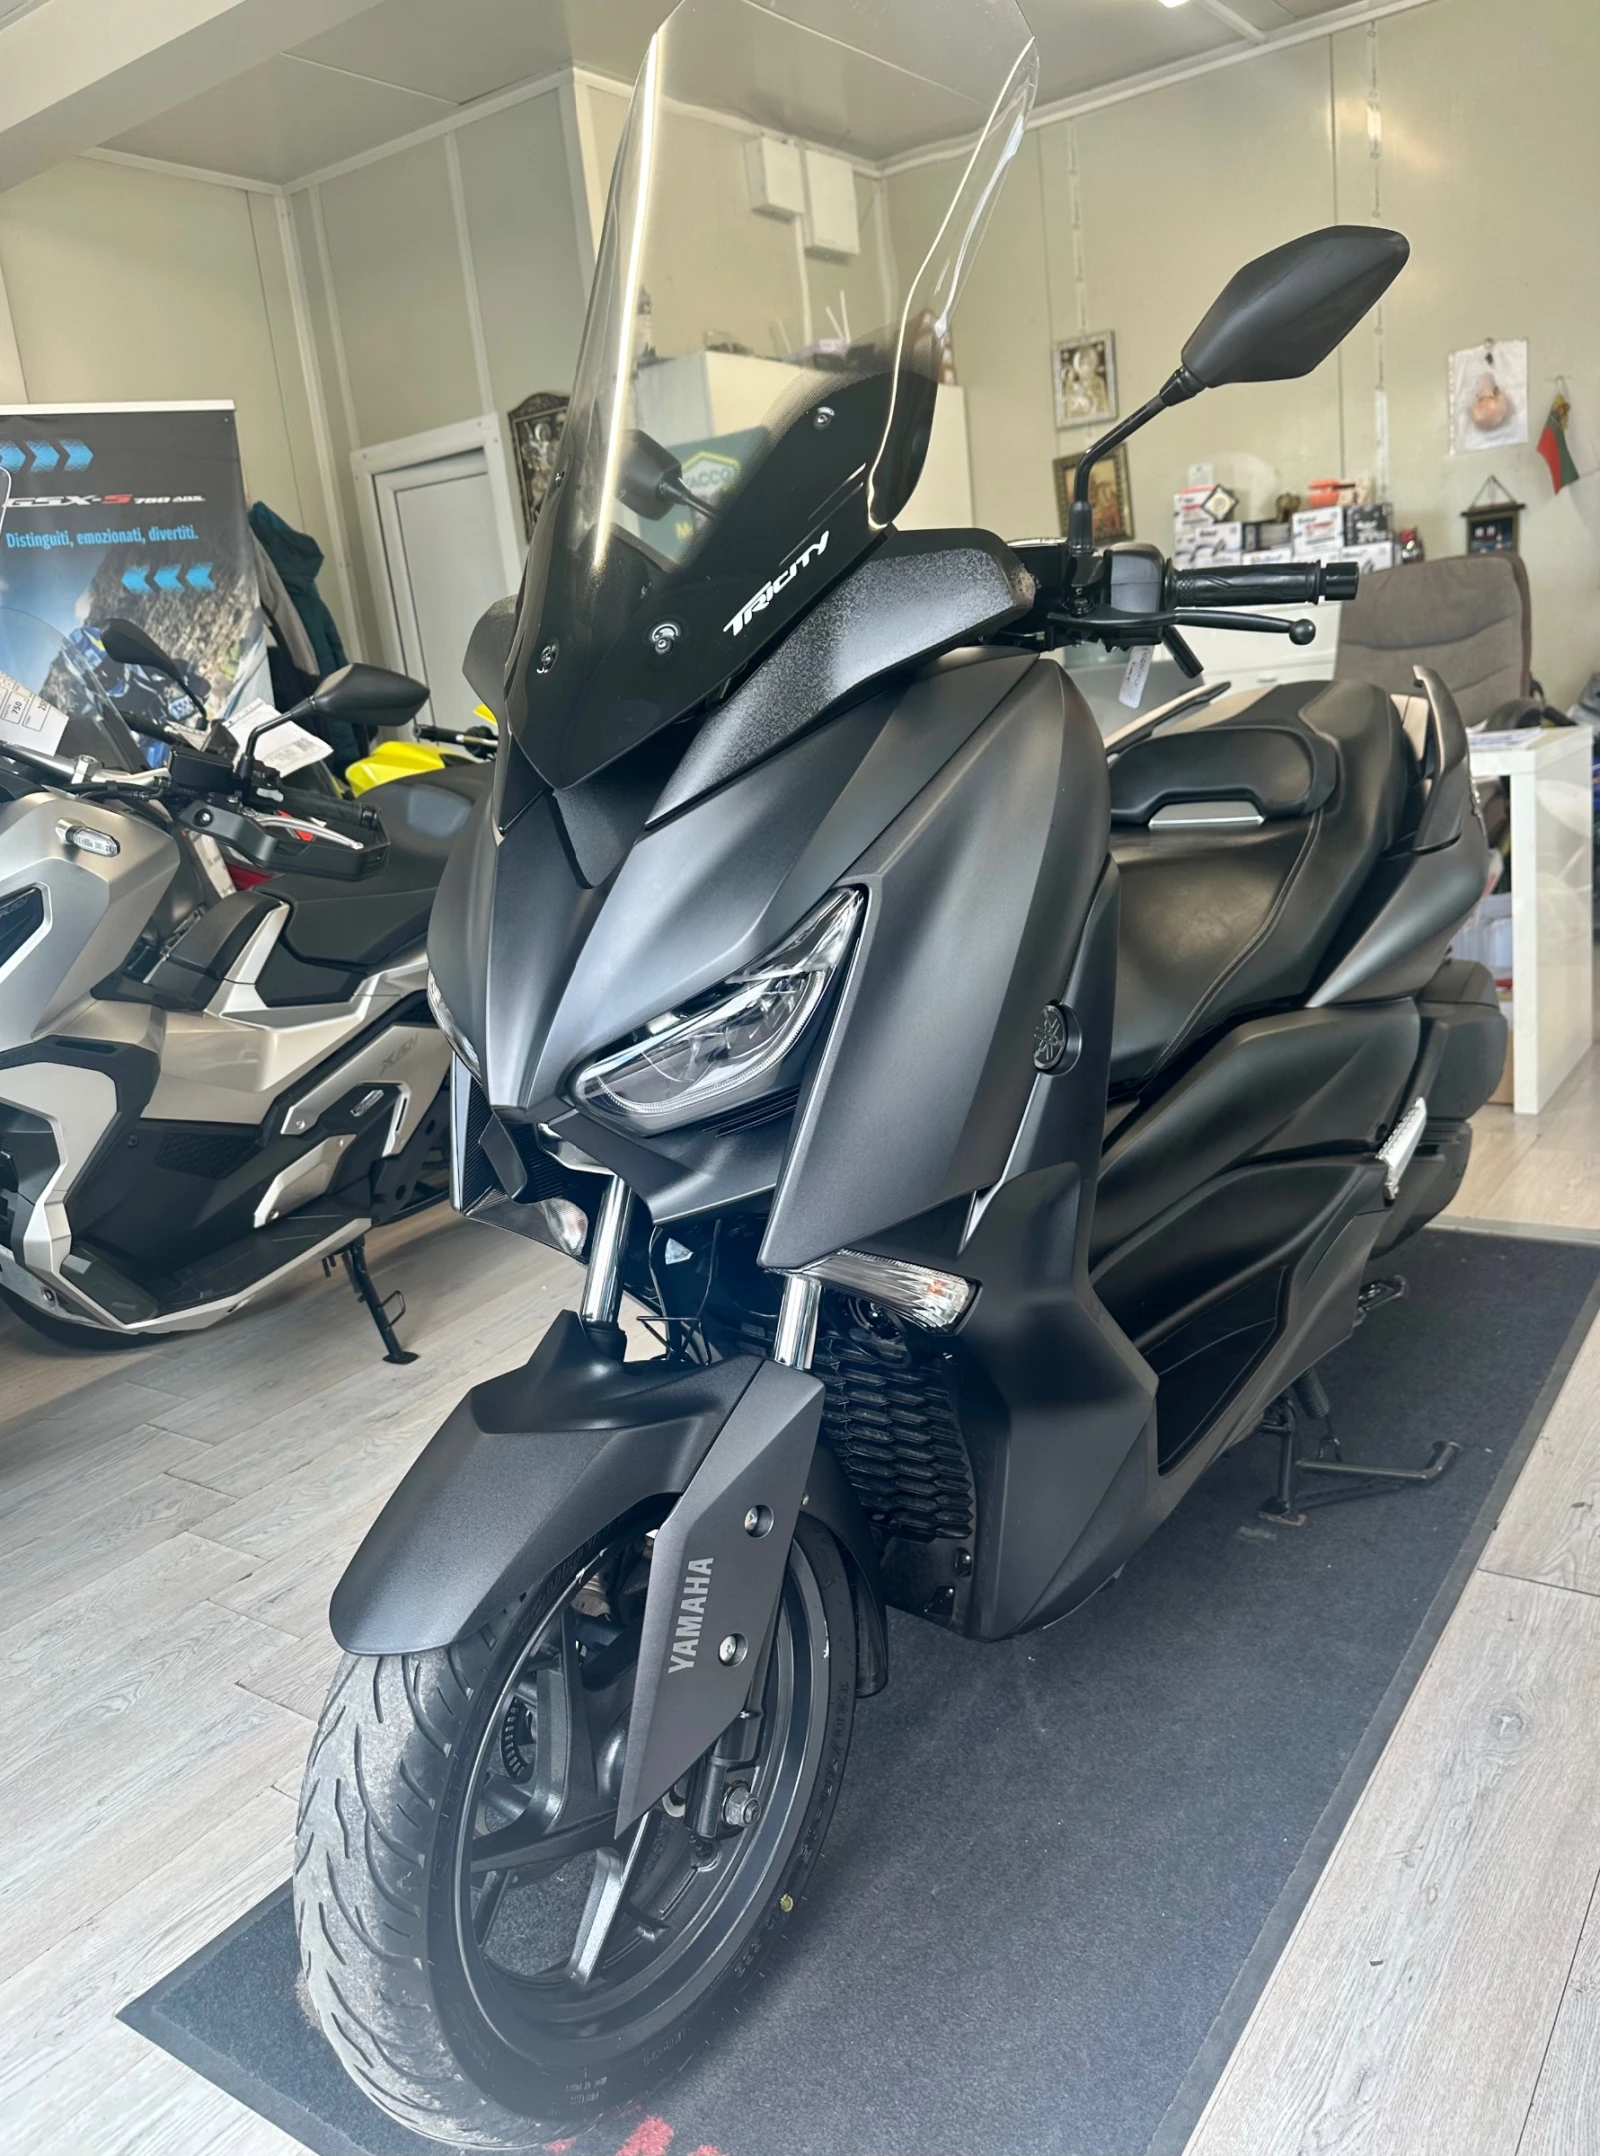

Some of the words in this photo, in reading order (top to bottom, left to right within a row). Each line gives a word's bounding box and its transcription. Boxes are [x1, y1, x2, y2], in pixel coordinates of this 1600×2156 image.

[6, 530, 74, 550] Distinguiti,
[76, 527, 147, 545] emozionati,
[148, 524, 199, 541] divertiti.
[722, 530, 829, 636] TRICITY
[667, 1557, 714, 1674] YAMAHA
